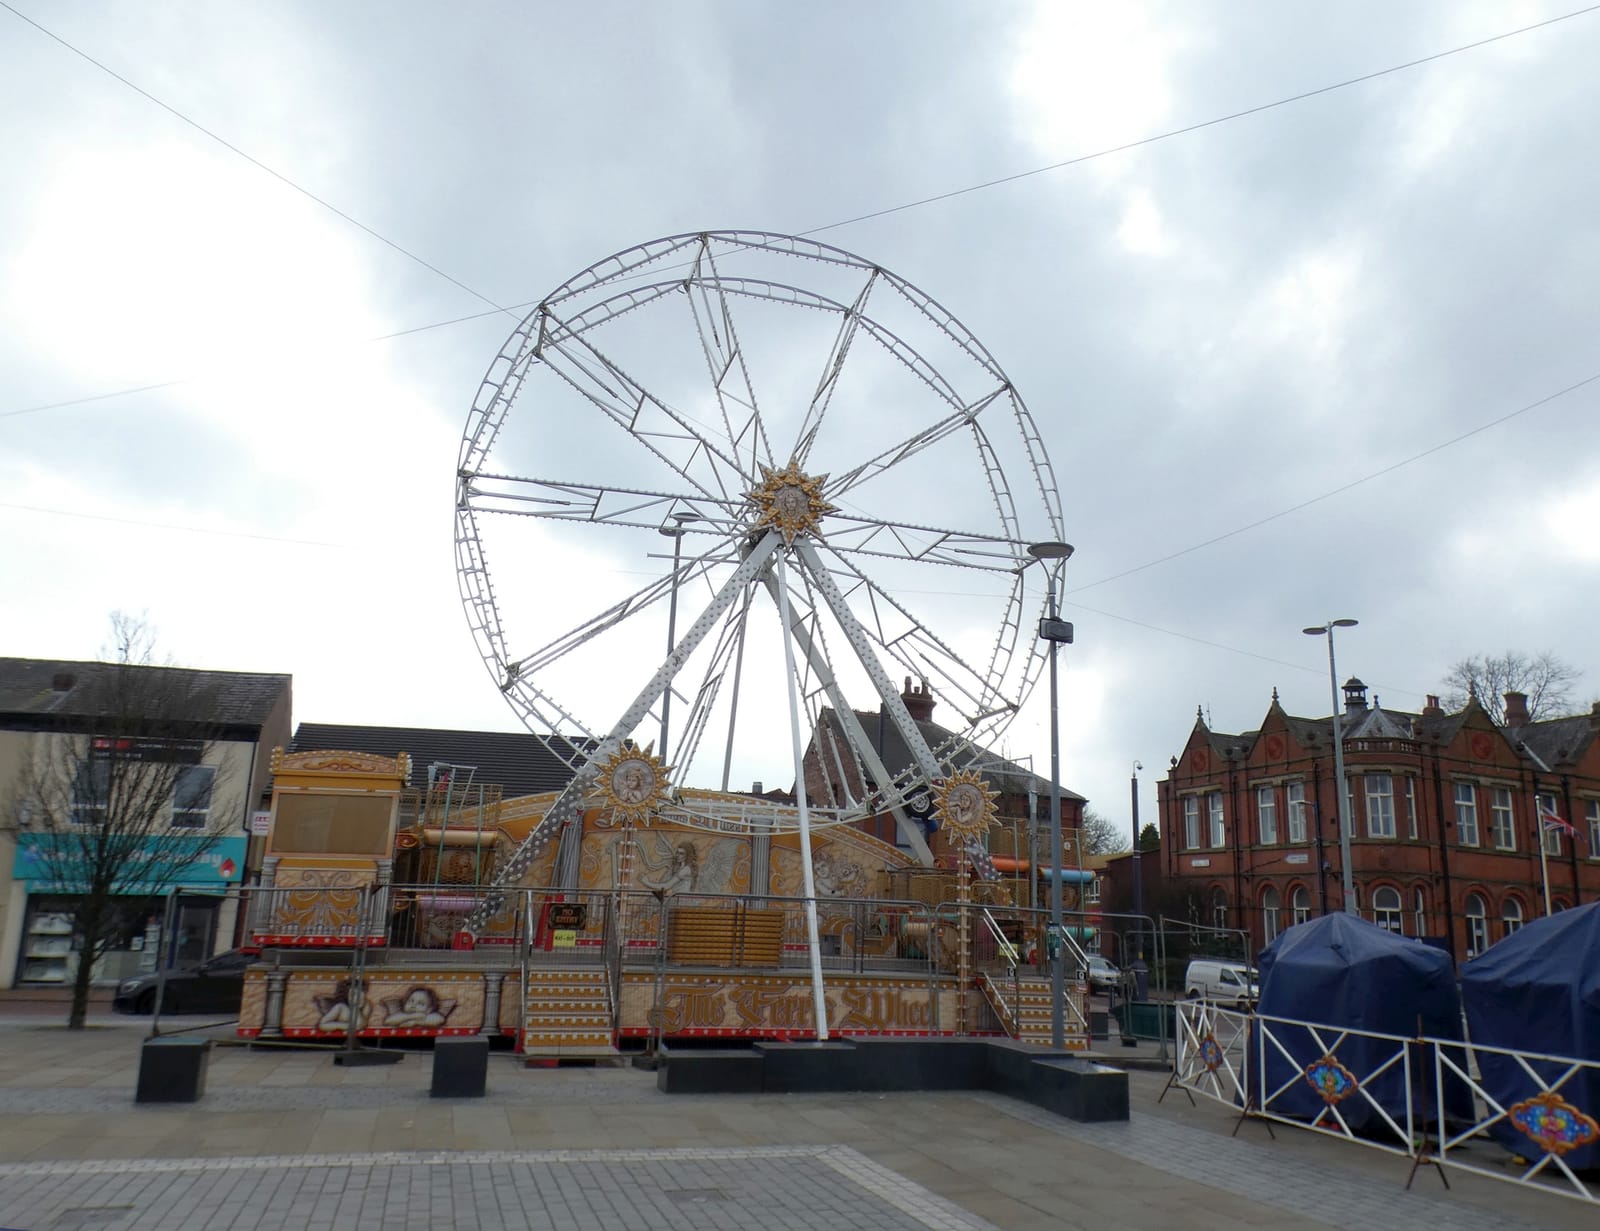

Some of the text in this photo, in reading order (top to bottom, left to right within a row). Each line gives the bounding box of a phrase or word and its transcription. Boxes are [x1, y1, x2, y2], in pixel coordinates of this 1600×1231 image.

[647, 983, 939, 1033] The Ferrs Wheel
